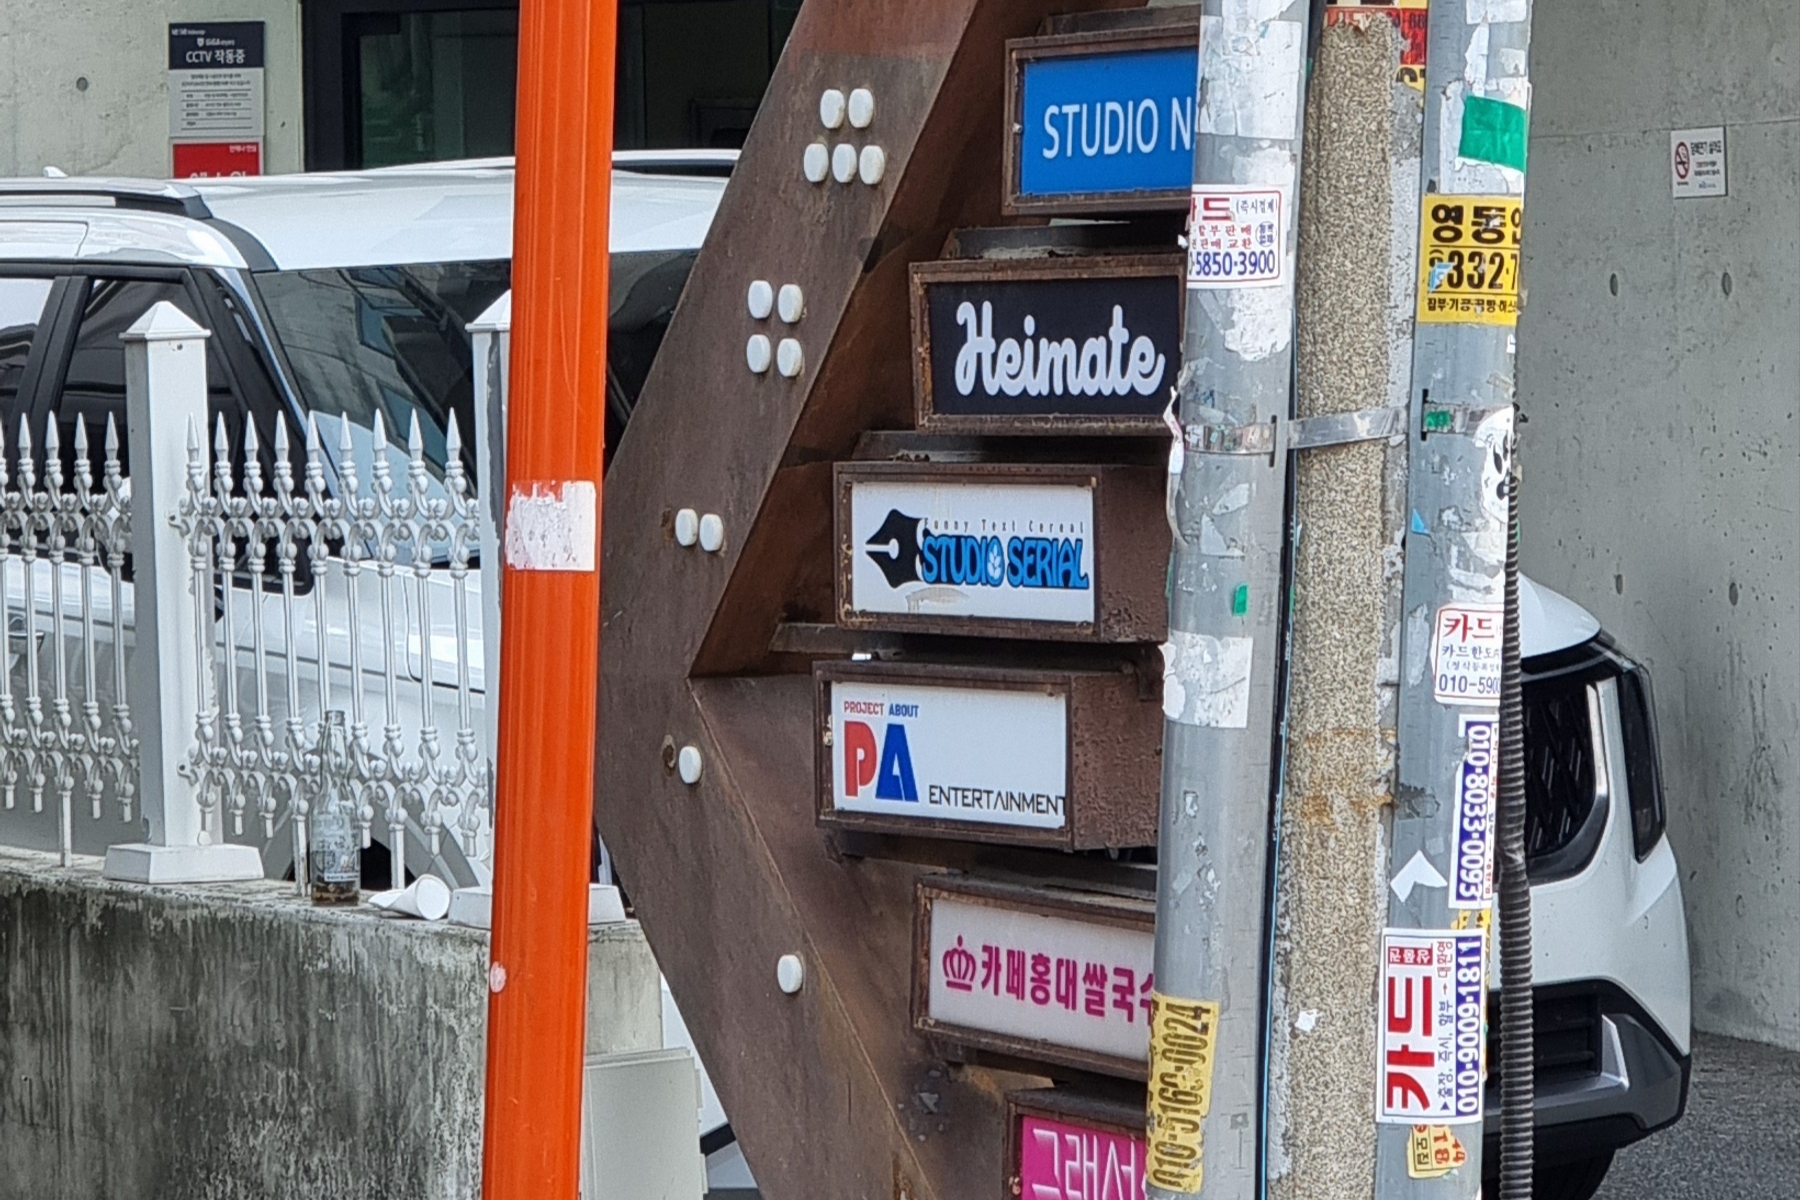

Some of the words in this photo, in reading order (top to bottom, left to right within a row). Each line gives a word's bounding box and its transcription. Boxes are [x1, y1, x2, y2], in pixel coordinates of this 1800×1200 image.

[186, 50, 212, 63] CCTV
[215, 49, 246, 64] 작동중
[1042, 98, 1159, 160] STUDIO
[1170, 96, 1194, 151] N
[954, 300, 1166, 397] Heimate
[921, 533, 1006, 588] STUDIO
[1006, 535, 1091, 591] SERIAL
[844, 700, 884, 716] PROJECT
[889, 702, 920, 719] ABOUT
[844, 720, 919, 803] PA
[1436, 941, 1454, 979] 대환영
[1386, 975, 1435, 1111] 카드
[1031, 1127, 1147, 1200] 그래서
